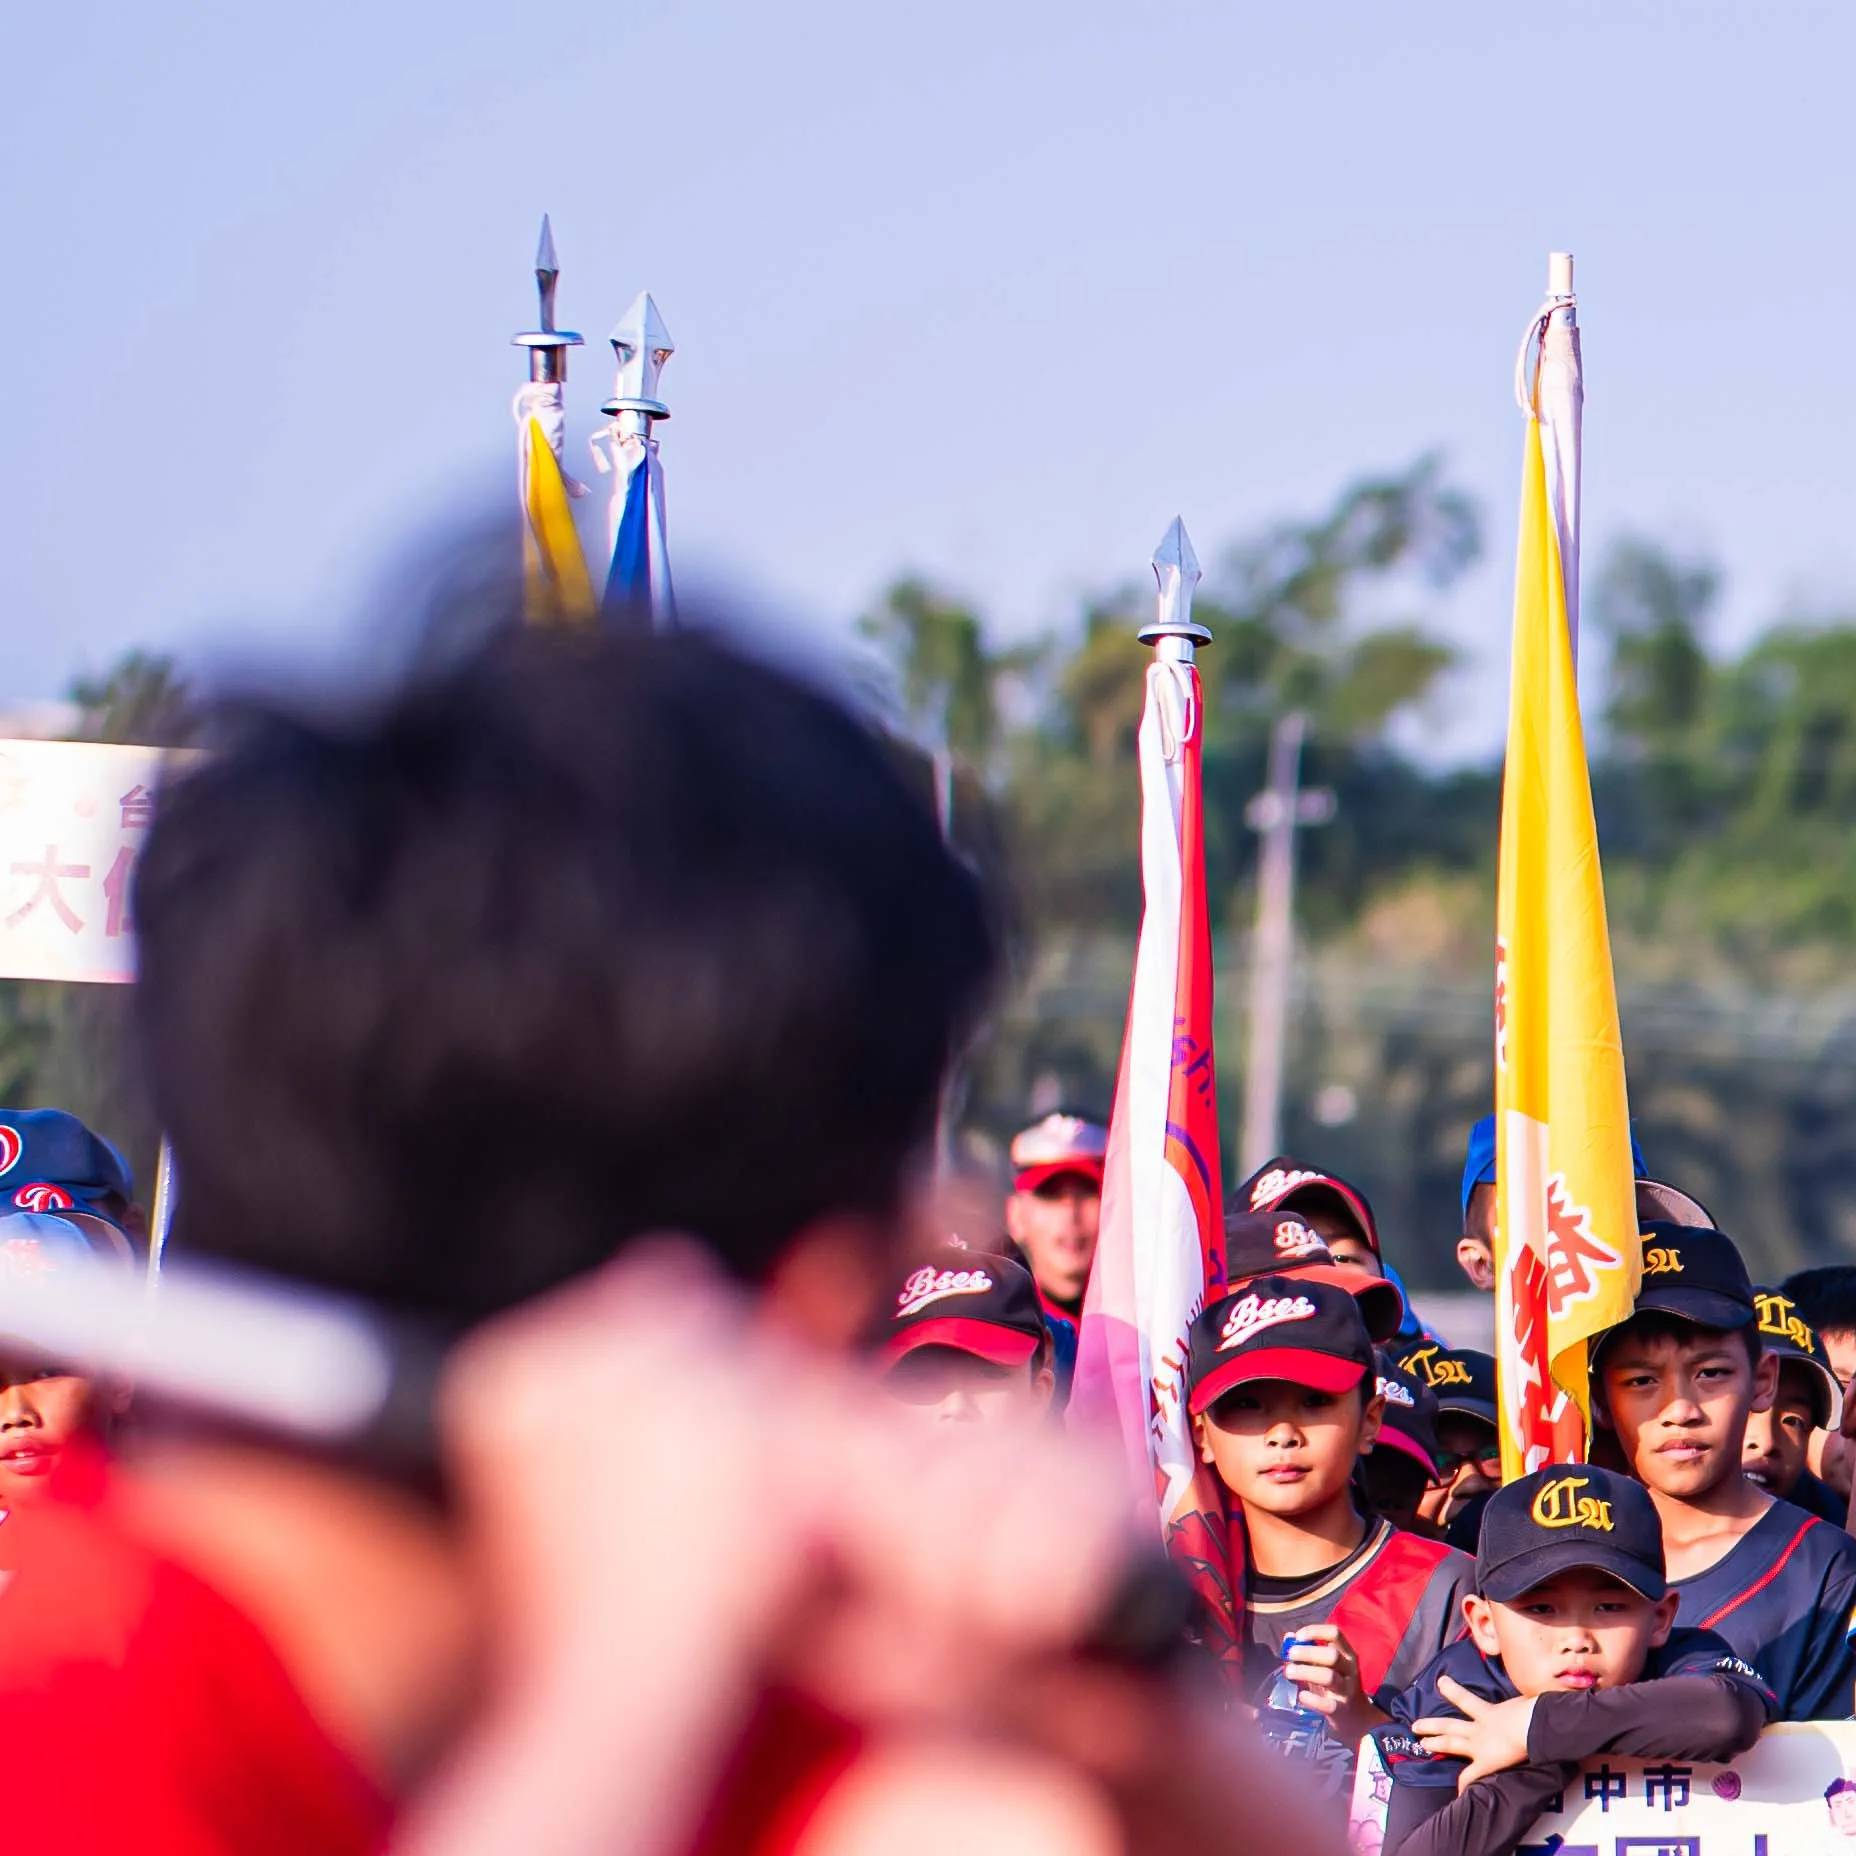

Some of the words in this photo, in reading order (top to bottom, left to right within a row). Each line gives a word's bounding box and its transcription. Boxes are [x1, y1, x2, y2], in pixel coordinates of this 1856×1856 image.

[4, 844, 137, 938] 大
[1218, 1294, 1317, 1348] Bses
[1546, 1763, 1693, 1813] 中市
